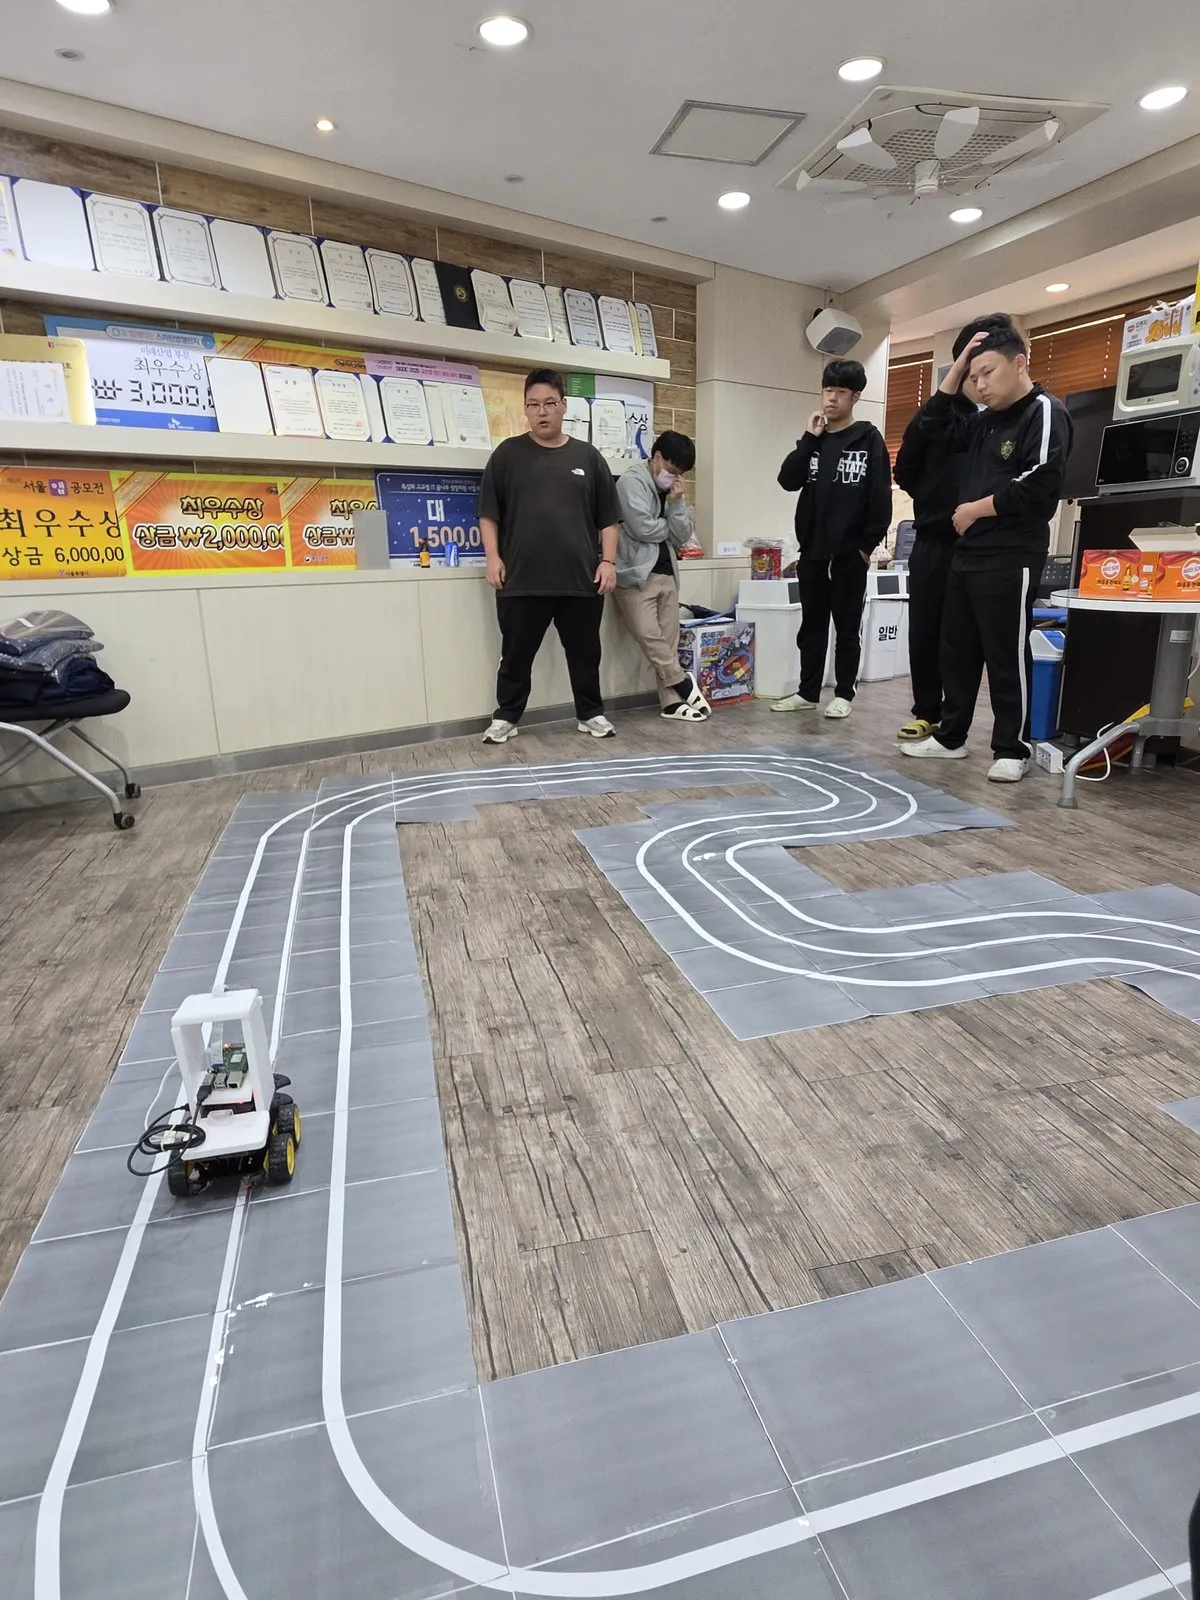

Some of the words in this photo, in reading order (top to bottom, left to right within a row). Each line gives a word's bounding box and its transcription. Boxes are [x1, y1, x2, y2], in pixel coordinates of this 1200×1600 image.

[134, 356, 204, 381] 최우수상
[837, 457, 868, 476] STATE
[23, 481, 46, 494] 서울
[51, 480, 66, 496] 앱
[70, 481, 104, 495] 공모전
[181, 495, 264, 521] 최우수상
[426, 499, 445, 522] 대
[0, 508, 121, 538] 최우수상
[409, 526, 481, 549] 1500,0
[2, 546, 44, 566] 상금
[54, 546, 125, 565] 6,000,00
[878, 624, 898, 641] 일반
